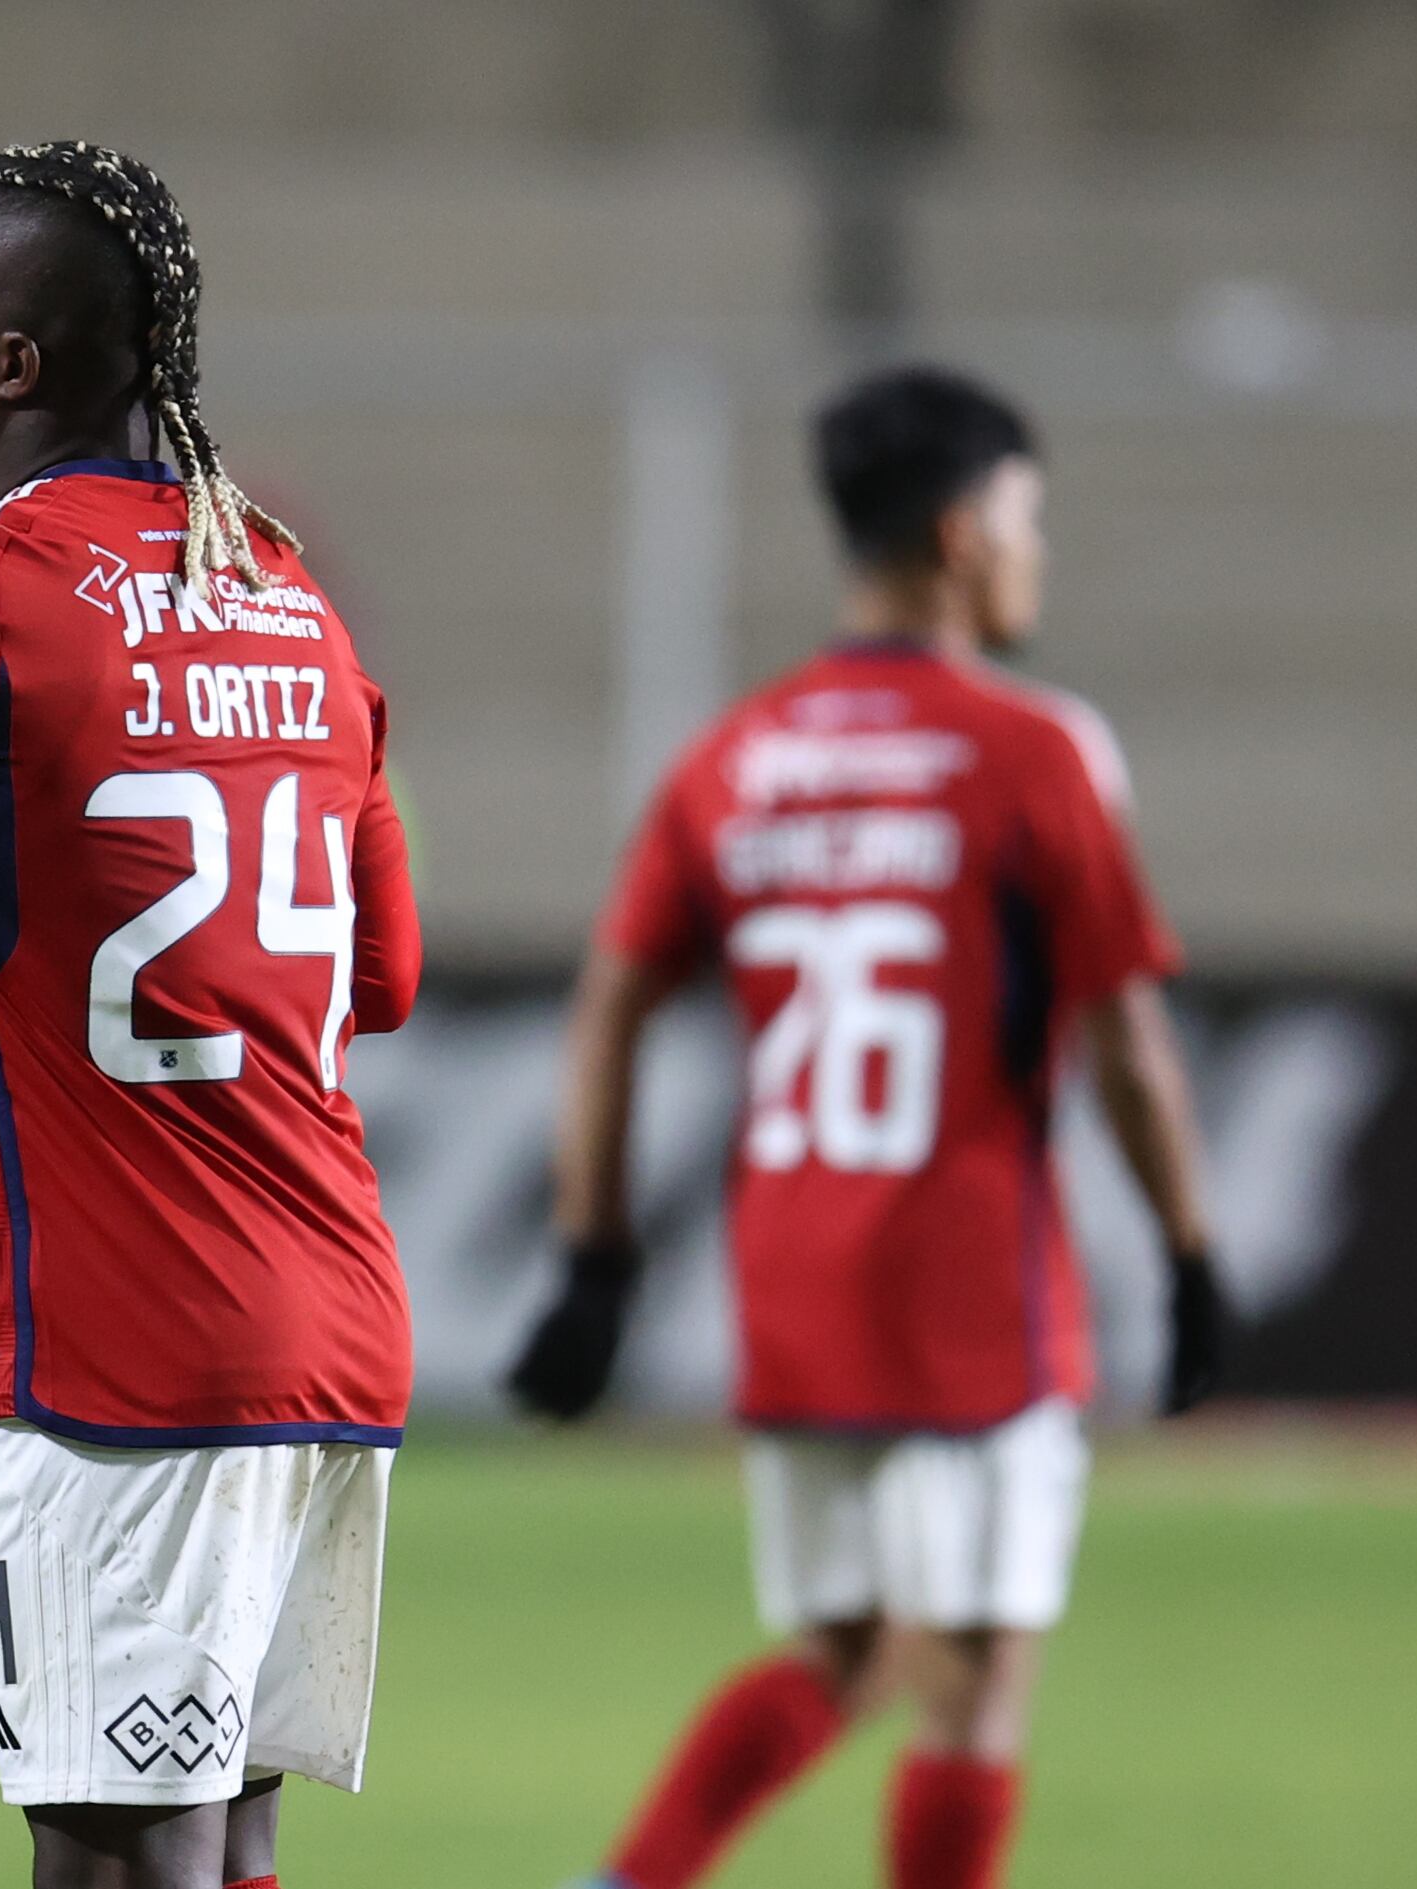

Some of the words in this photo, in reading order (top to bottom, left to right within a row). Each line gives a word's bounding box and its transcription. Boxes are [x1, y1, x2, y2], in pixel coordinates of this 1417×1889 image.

[117, 572, 224, 648] JFK
[222, 601, 323, 640] Financiera
[125, 663, 174, 737] J.
[186, 664, 330, 739] ORTIZ
[84, 770, 355, 1091] 24
[724, 900, 947, 1174] 26
